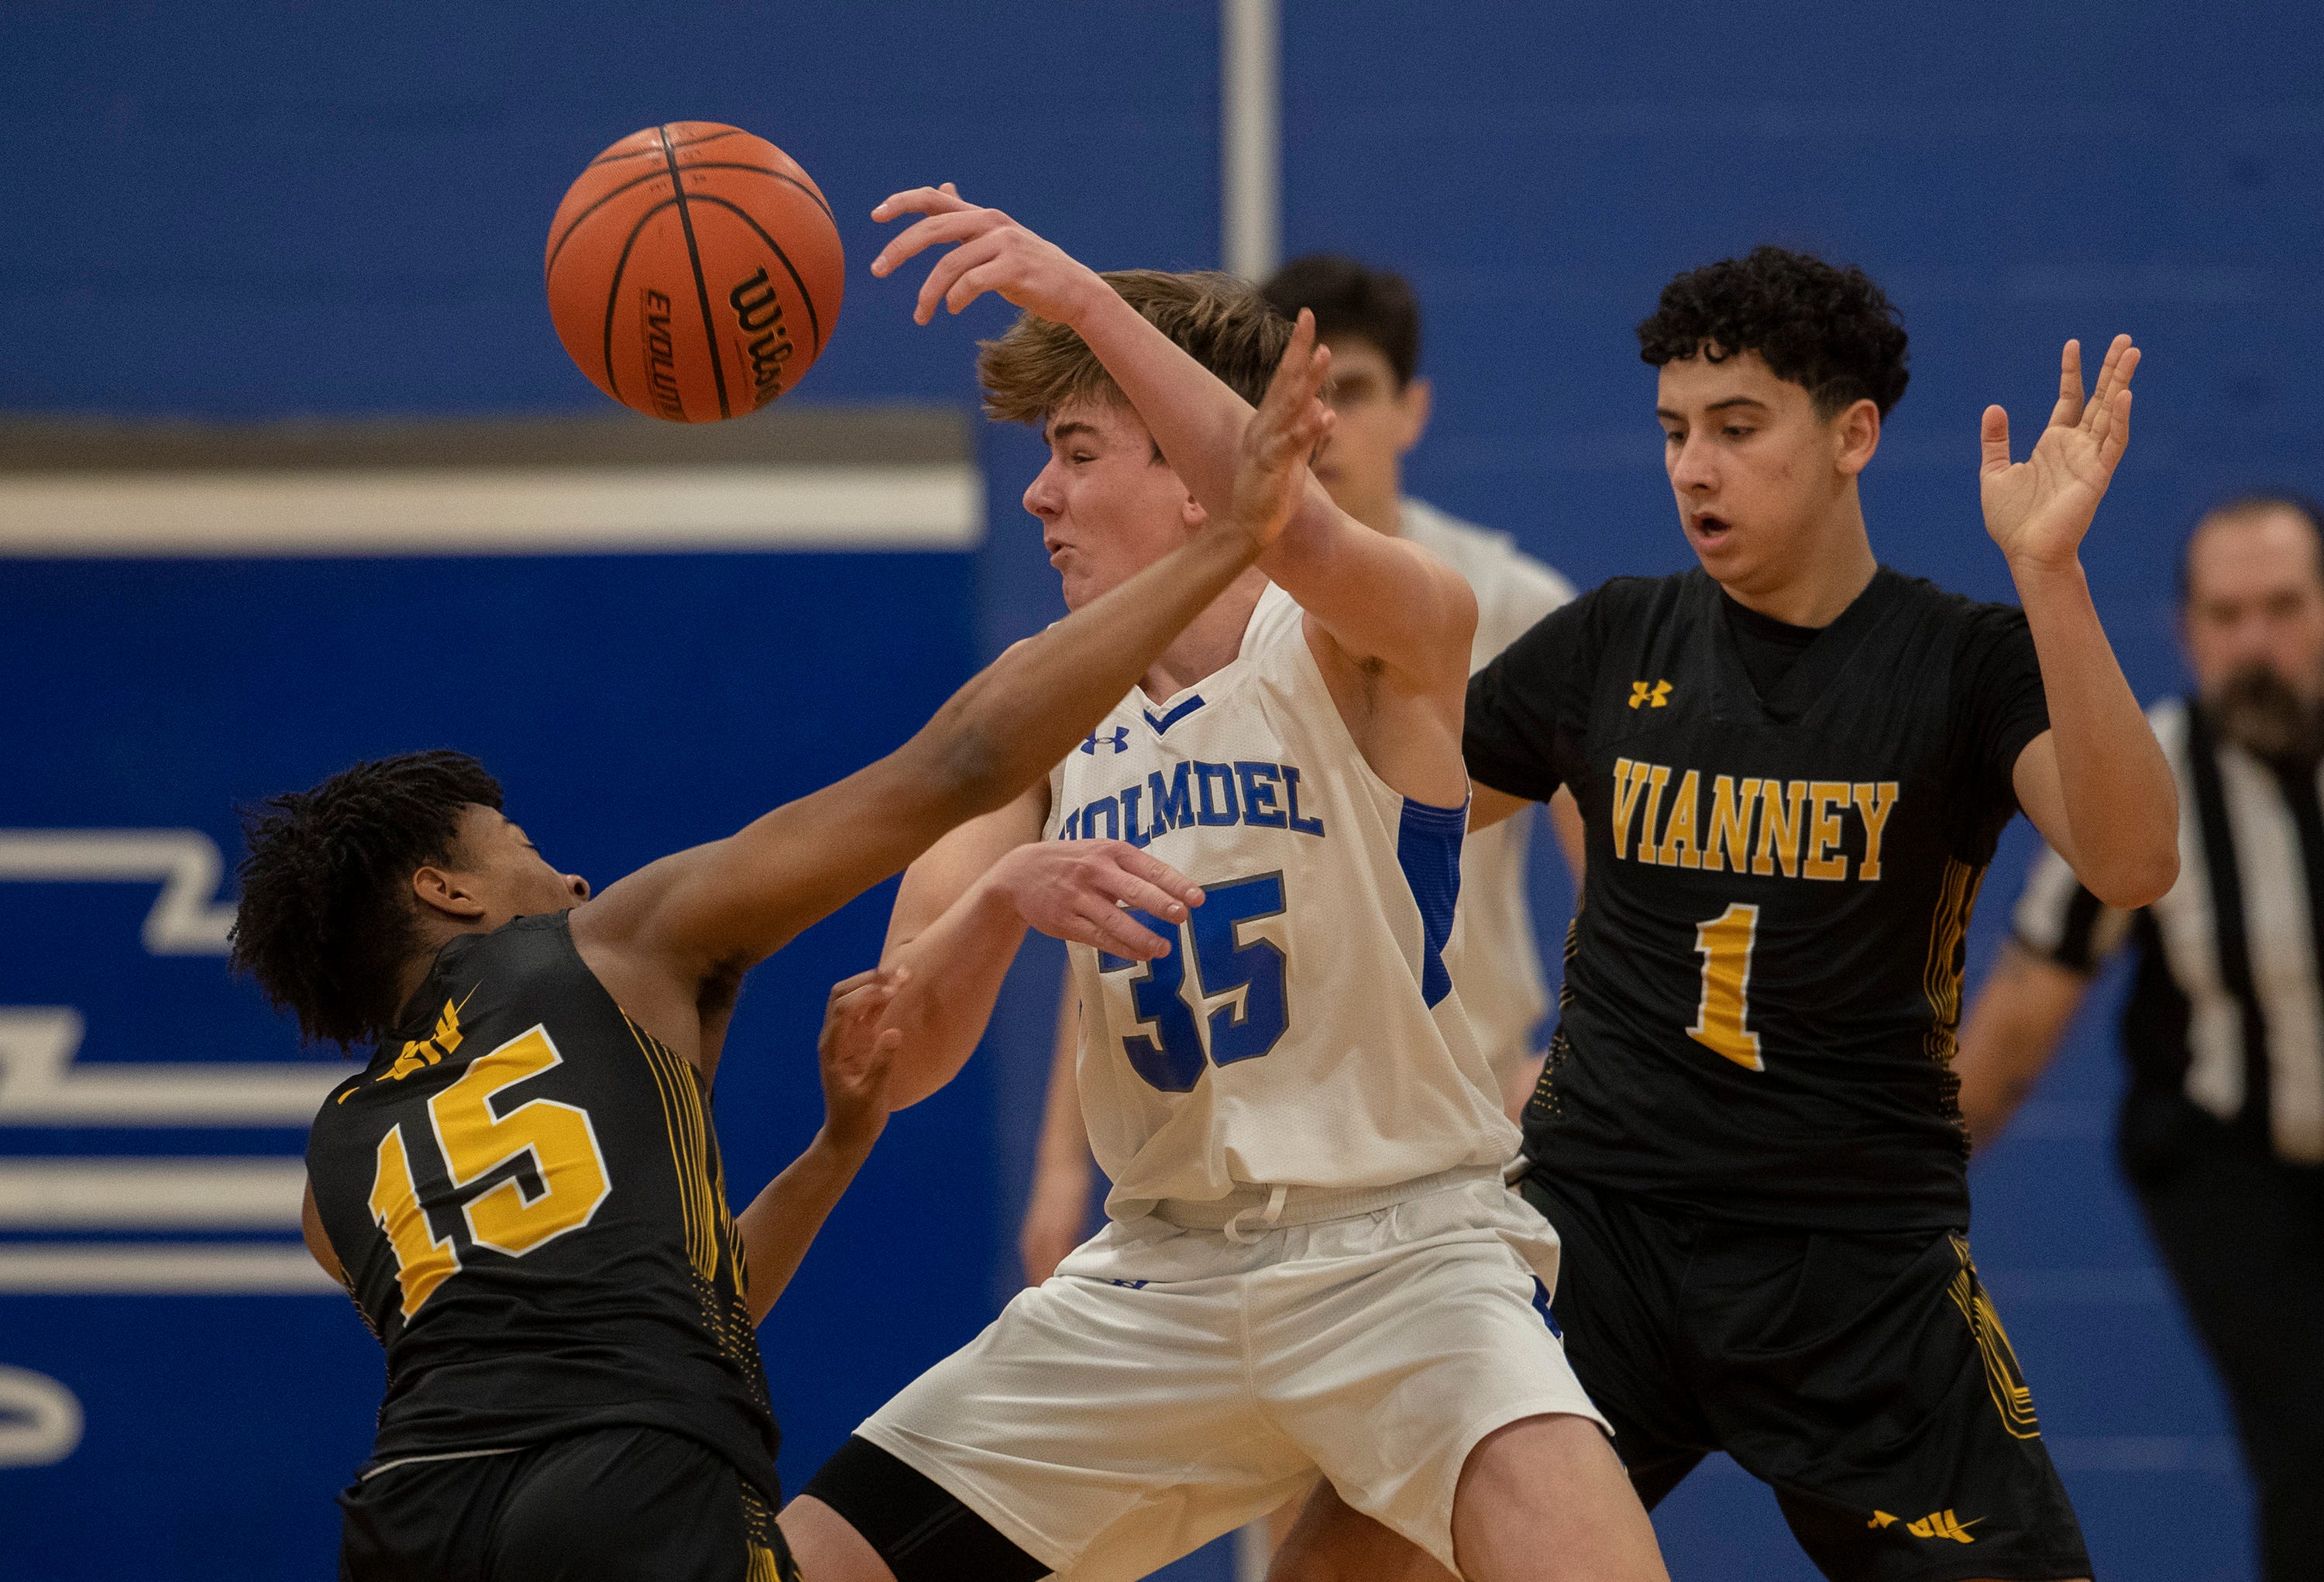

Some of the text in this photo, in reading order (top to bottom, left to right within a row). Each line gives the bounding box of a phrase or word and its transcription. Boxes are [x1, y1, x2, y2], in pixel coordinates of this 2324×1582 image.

[729, 265, 794, 409] Wils
[1612, 757, 1899, 882] VIANNEY
[1098, 868, 1290, 1092] 35
[1685, 902, 1765, 1072] 1
[367, 1023, 613, 1328] 15
